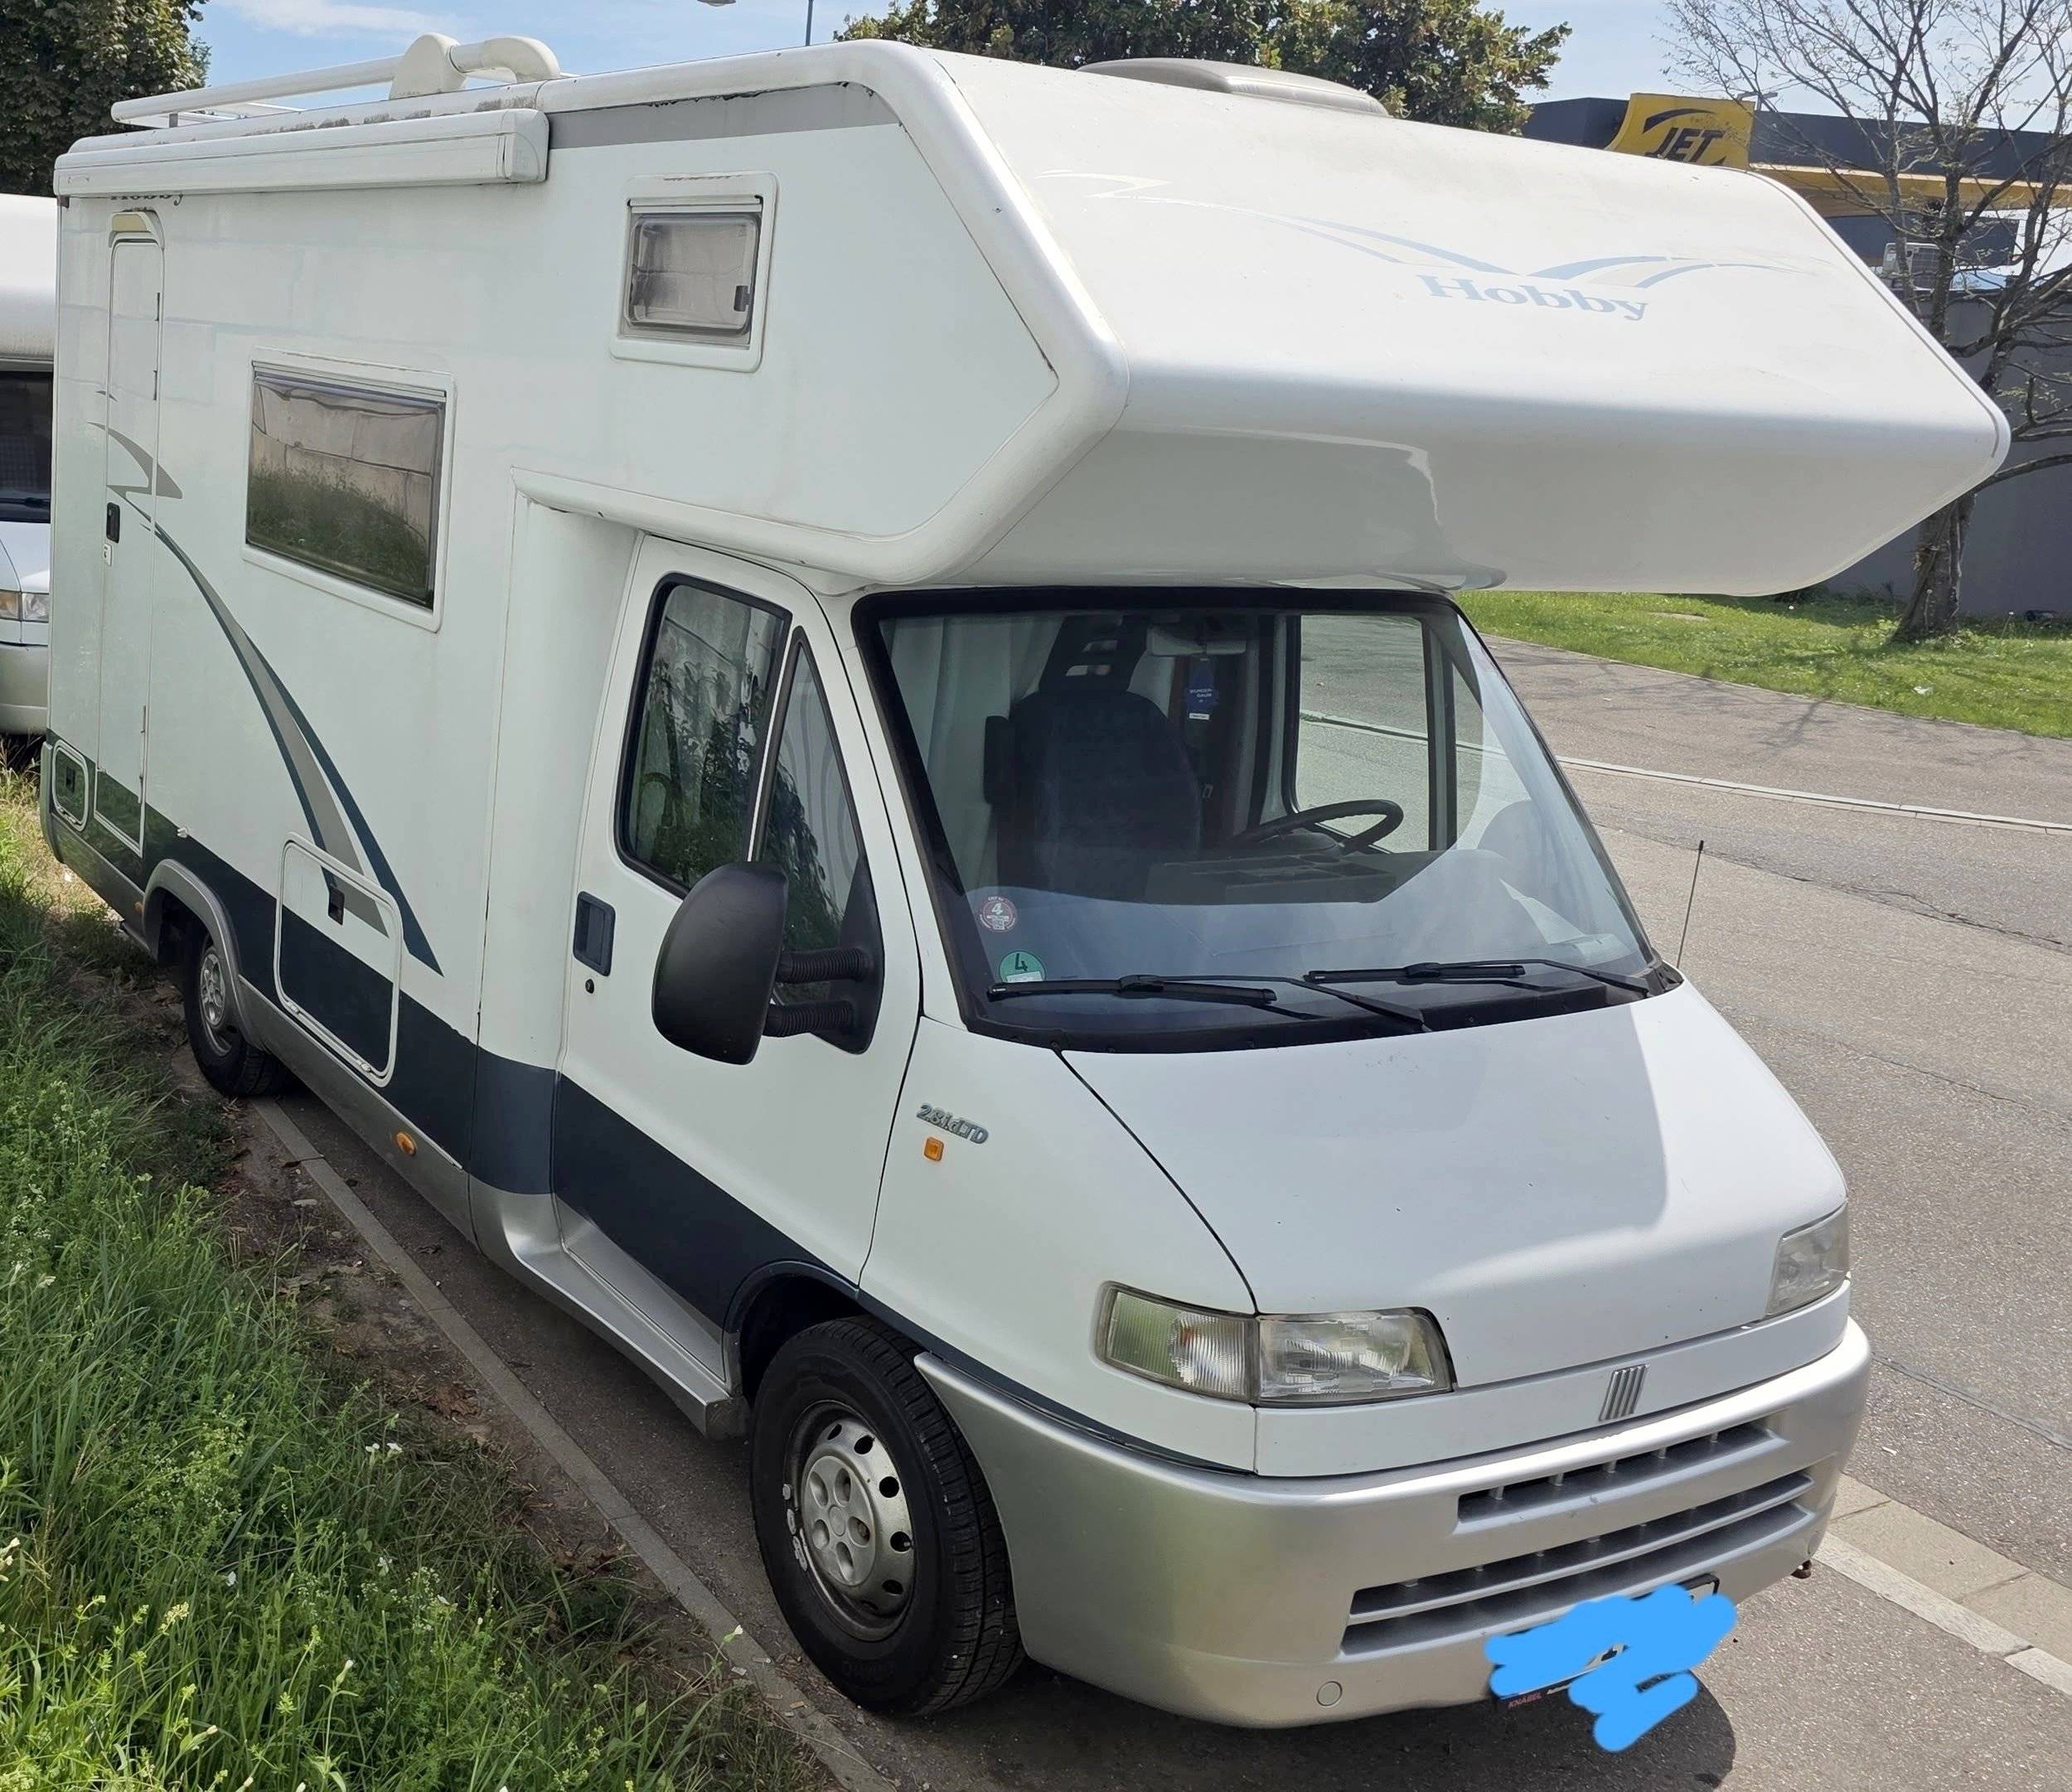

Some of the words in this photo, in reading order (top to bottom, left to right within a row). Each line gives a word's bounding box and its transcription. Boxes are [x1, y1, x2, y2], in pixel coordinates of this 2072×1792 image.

[1644, 127, 1726, 162] JET
[1416, 274, 1648, 322] Hobby
[991, 903, 1003, 915] 4
[1014, 953, 1028, 971] 4
